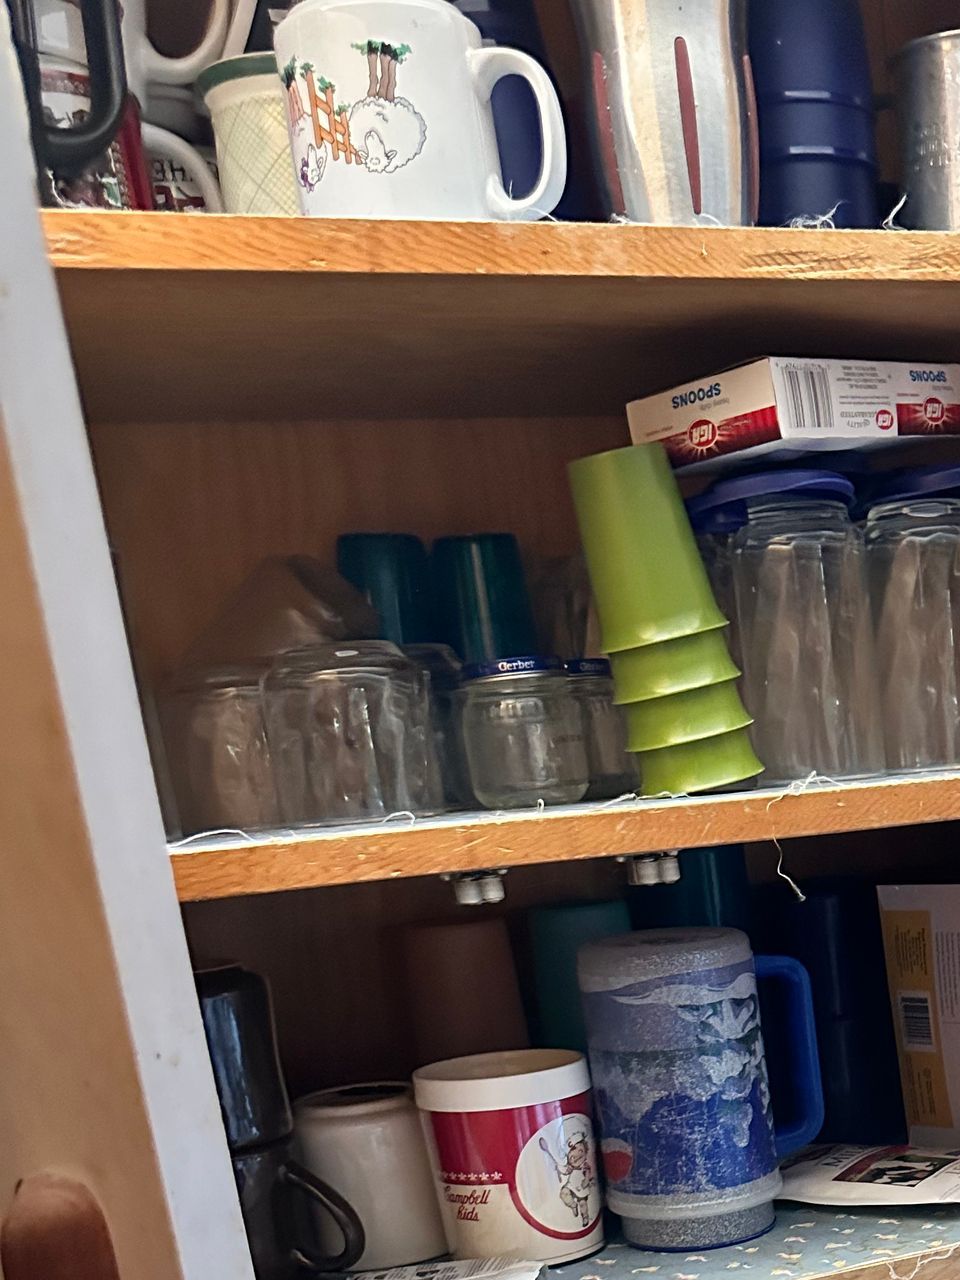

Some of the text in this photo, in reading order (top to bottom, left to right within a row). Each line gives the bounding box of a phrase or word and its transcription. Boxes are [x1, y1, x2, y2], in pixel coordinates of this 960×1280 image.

[909, 370, 947, 382] SPOONS
[672, 382, 721, 409] SPOONS
[926, 402, 942, 418] IGA
[878, 413, 891, 427] IGA
[692, 423, 712, 444] IGA
[498, 660, 535, 671] Gerber
[444, 1185, 491, 1206] Campbell
[456, 1205, 480, 1222] Kids
